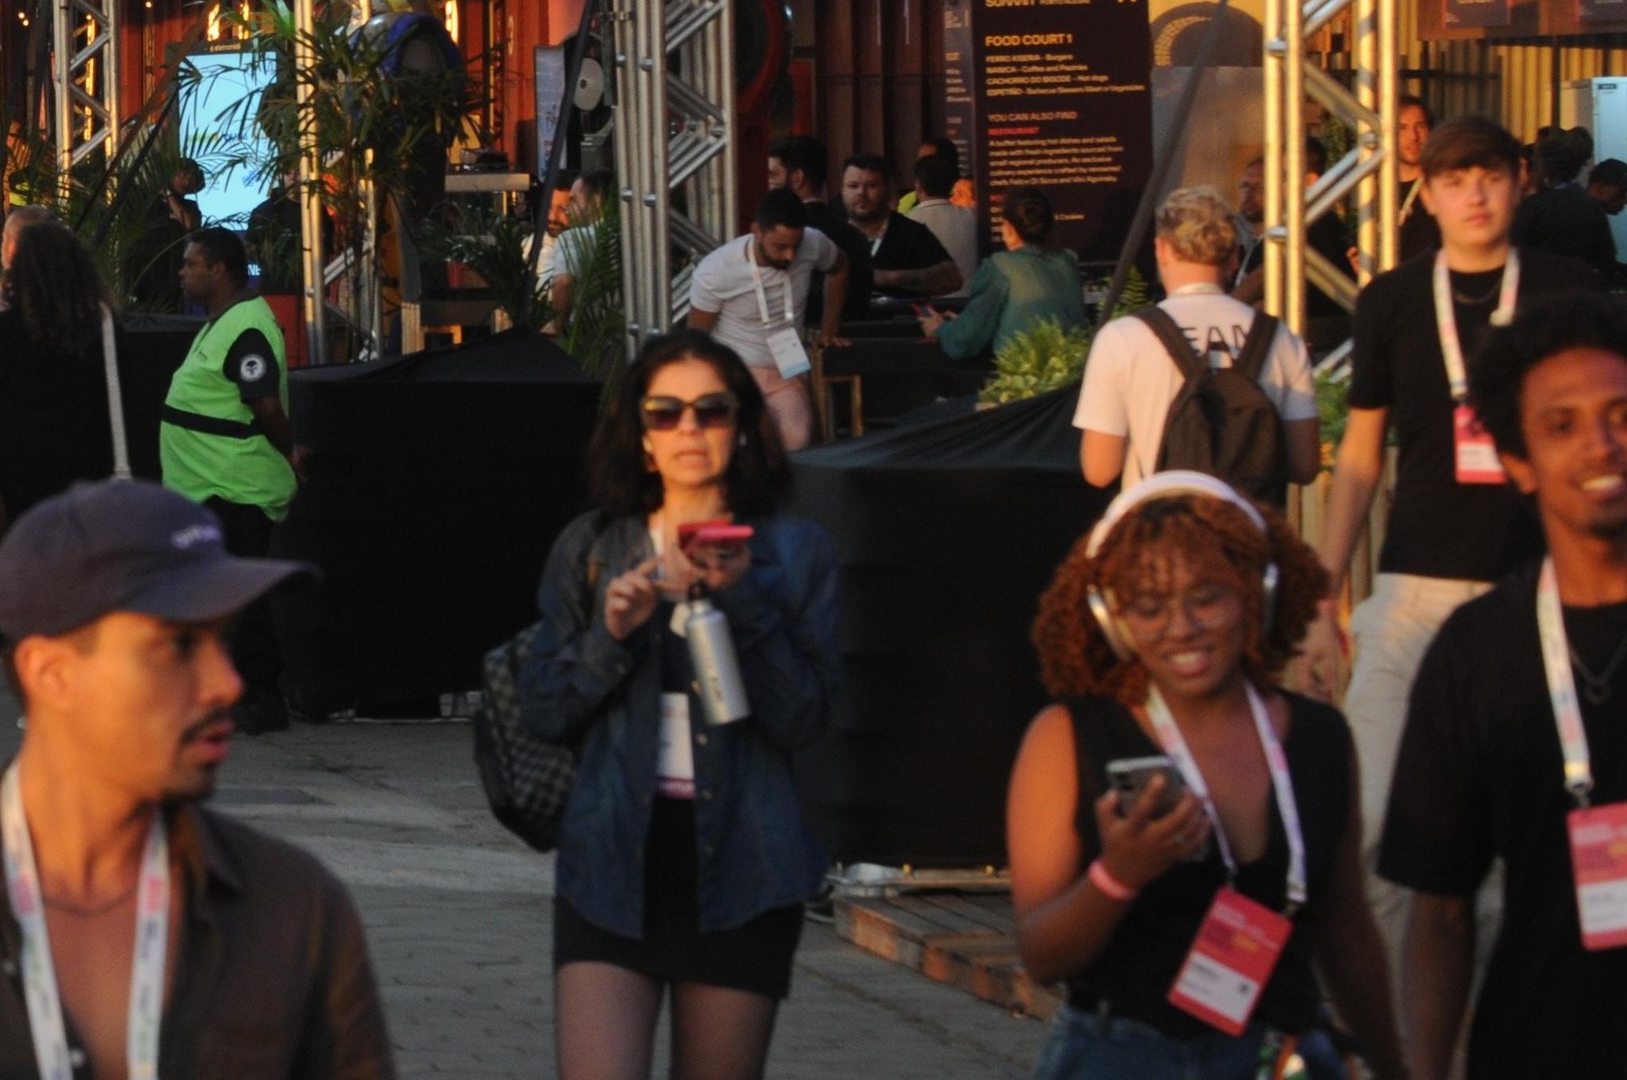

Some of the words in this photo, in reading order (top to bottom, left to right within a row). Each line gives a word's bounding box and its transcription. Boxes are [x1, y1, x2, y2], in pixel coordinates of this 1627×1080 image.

[985, 35, 1021, 47] FOOD
[1022, 34, 1065, 46] COURT
[1067, 33, 1073, 44] 1
[988, 114, 1008, 122] YOU
[1008, 113, 1029, 121] CAN
[1030, 112, 1054, 120] ALSO
[1055, 111, 1078, 119] FIND
